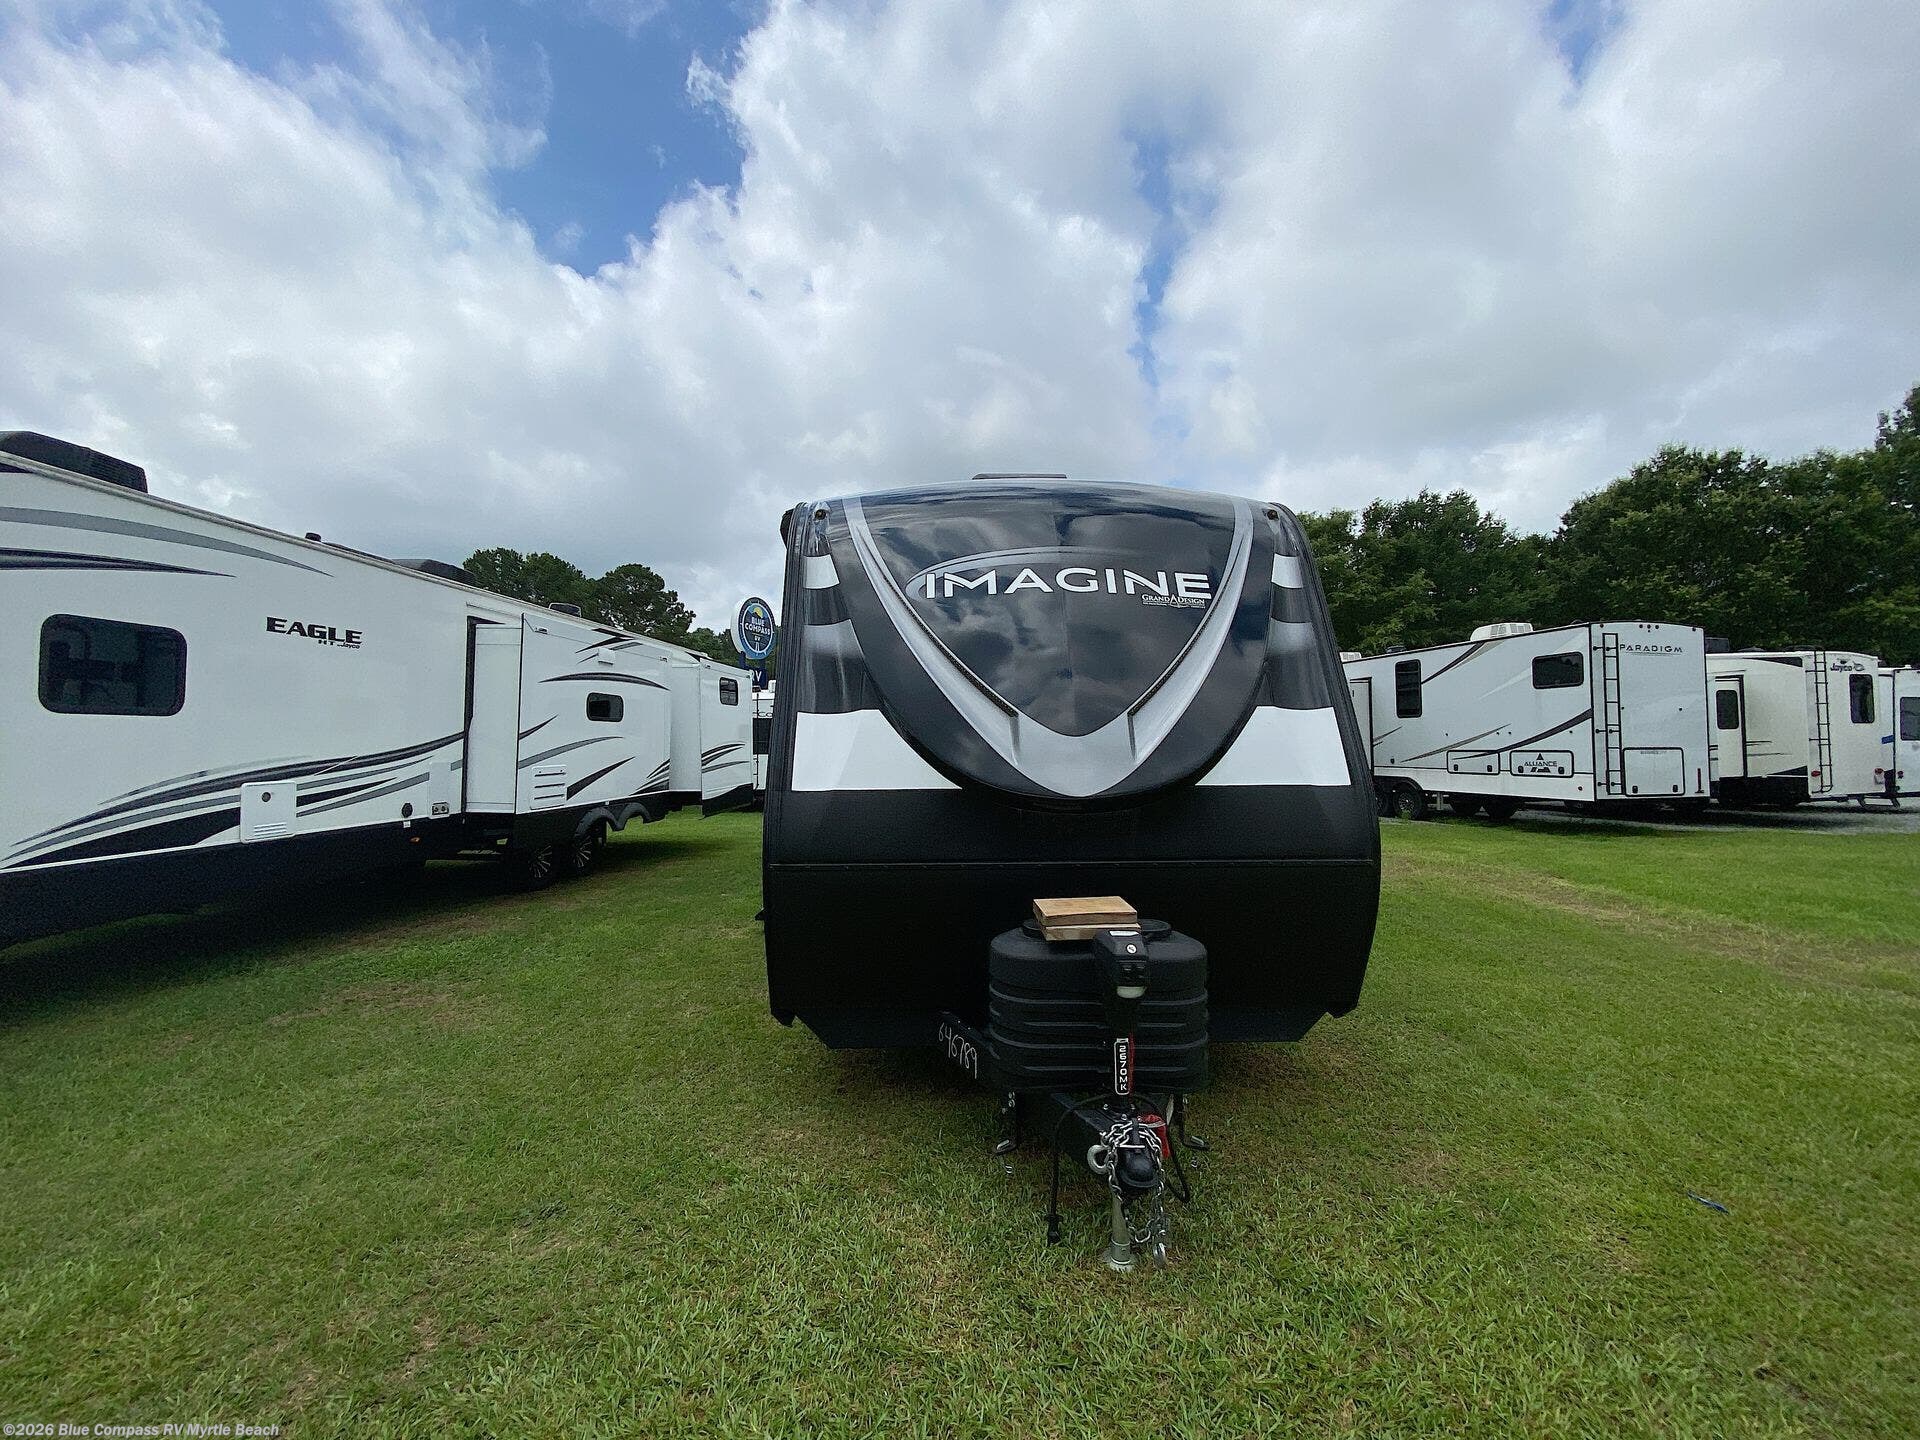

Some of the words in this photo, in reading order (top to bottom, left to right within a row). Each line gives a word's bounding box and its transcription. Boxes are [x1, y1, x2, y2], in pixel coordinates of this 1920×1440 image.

[926, 568, 1212, 599] IMAGINE
[752, 617, 765, 627] BLUE
[266, 616, 362, 645] EAGLE
[745, 623, 770, 635] COMPASS
[337, 642, 361, 650] Jayco
[1620, 643, 1683, 653] PARADIGM
[1830, 663, 1852, 672] Jayco
[1119, 1045, 1128, 1091] 2670MK
